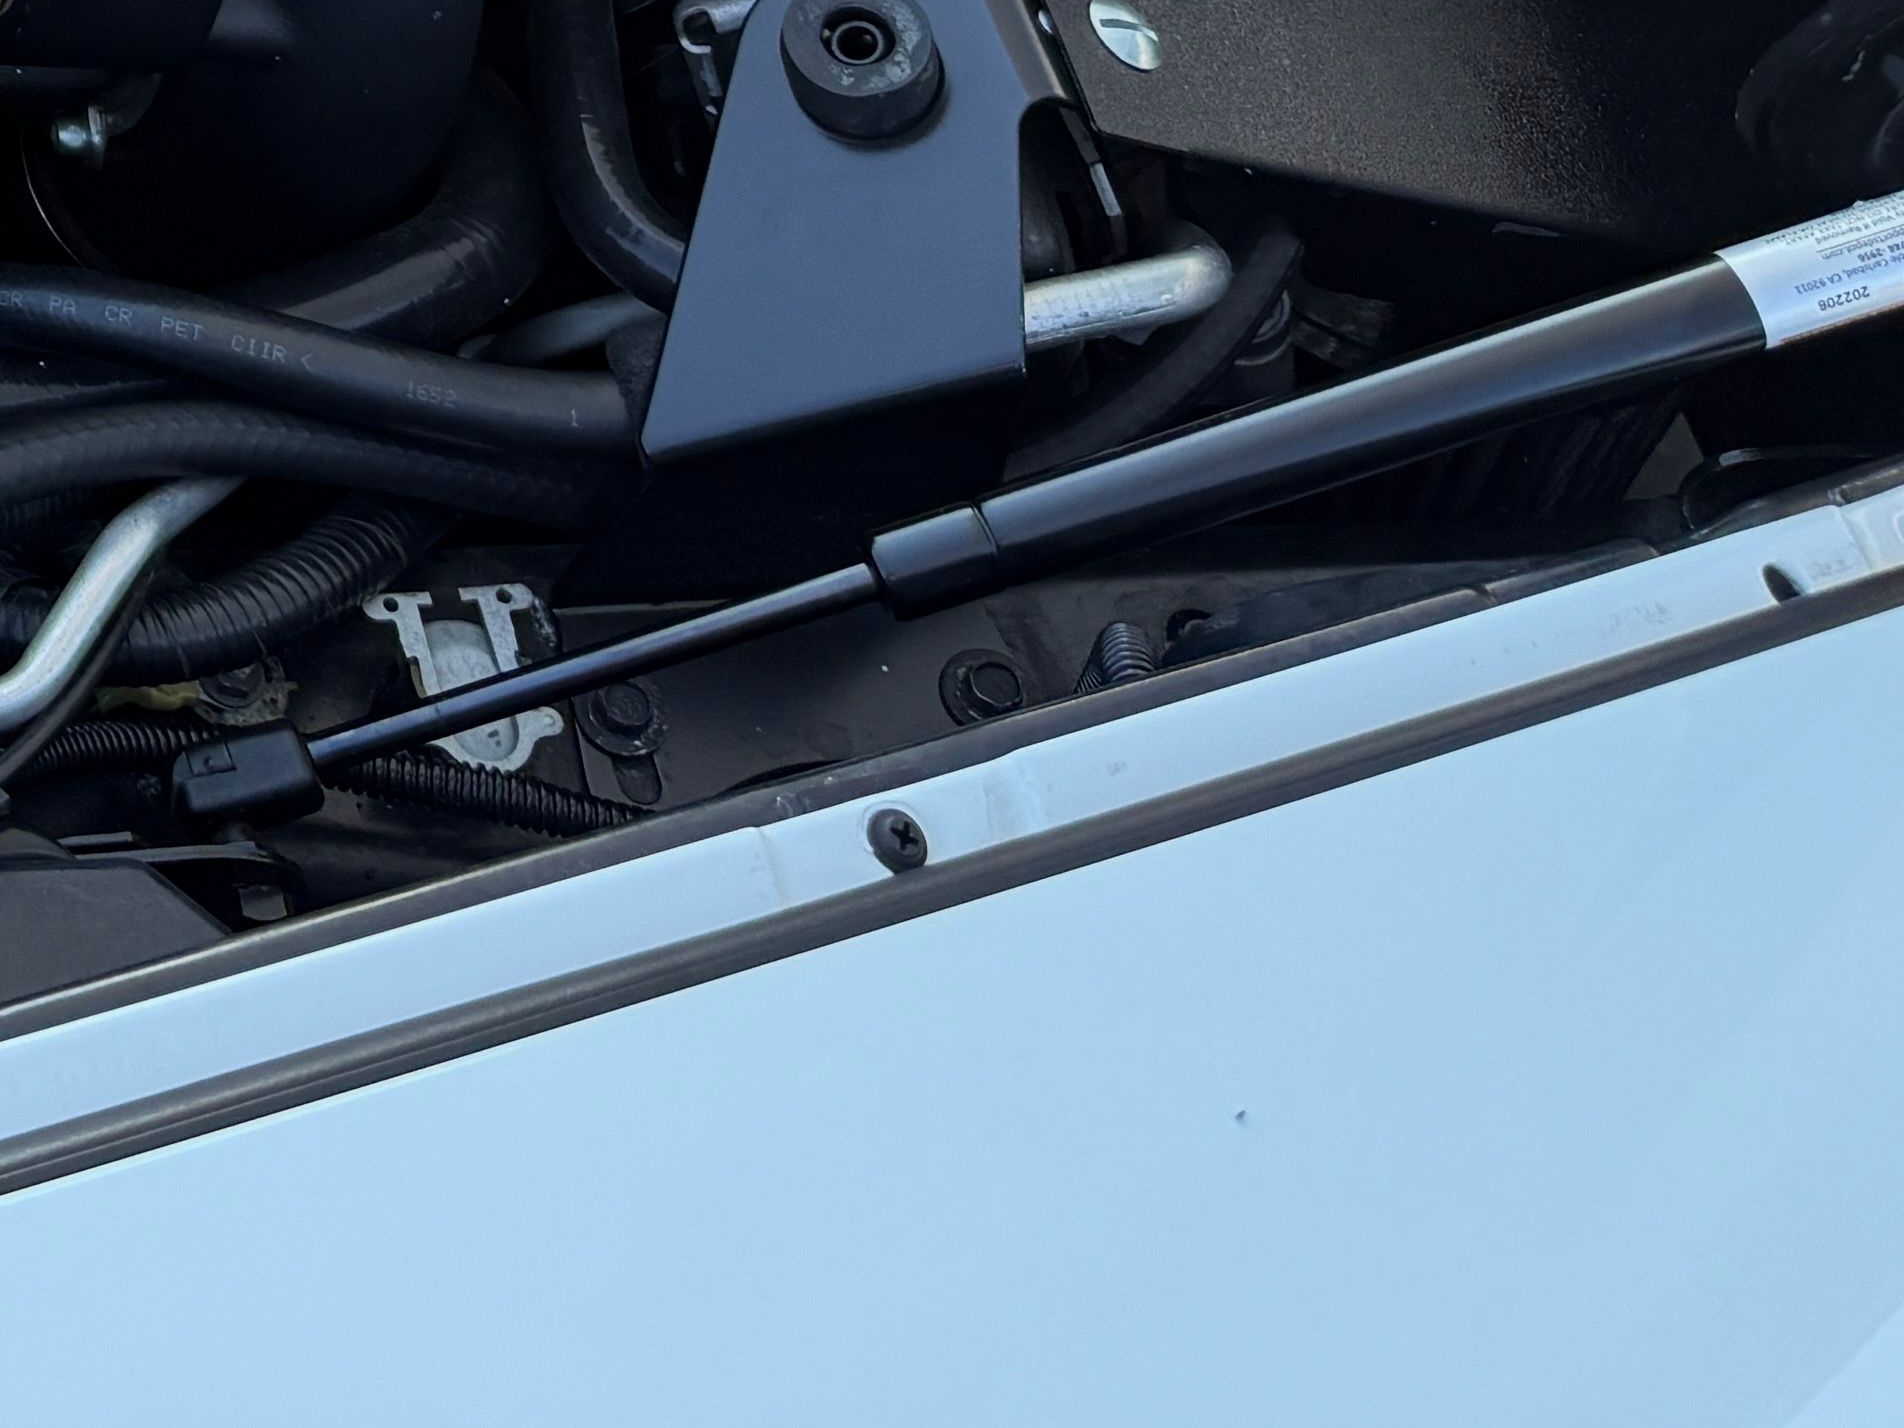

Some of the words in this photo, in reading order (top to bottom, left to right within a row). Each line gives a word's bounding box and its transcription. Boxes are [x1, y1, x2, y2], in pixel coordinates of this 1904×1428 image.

[1826, 272, 1842, 285] CA
[1817, 285, 1871, 312] 202208
[48, 294, 77, 316] PA
[104, 304, 134, 328] CR
[159, 316, 205, 343] PET
